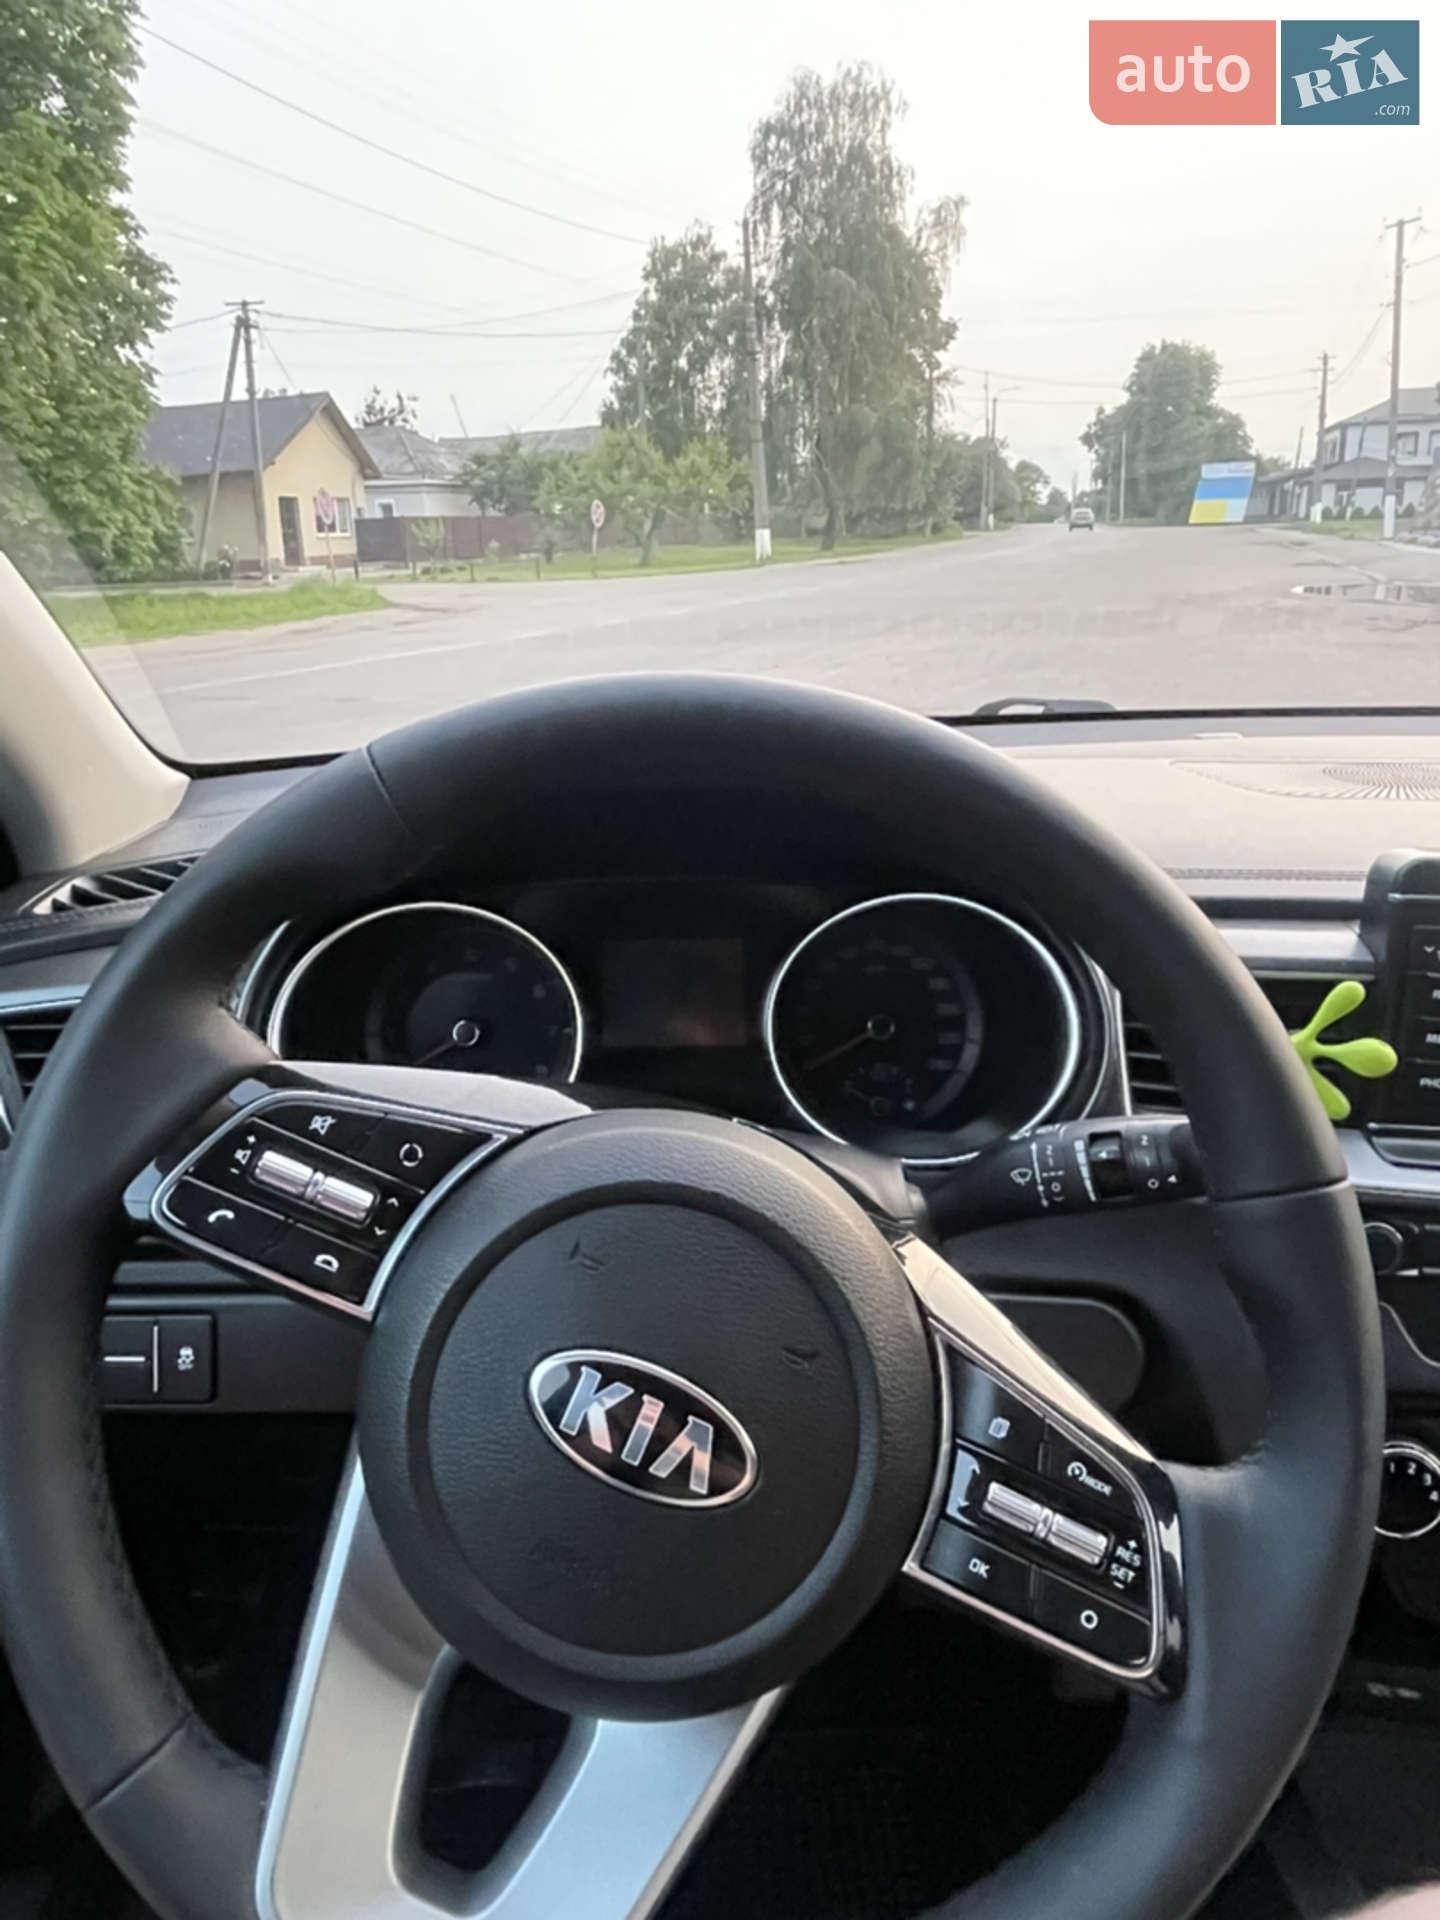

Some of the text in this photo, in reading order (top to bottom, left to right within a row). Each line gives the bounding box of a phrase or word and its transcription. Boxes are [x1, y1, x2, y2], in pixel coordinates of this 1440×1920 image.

[559, 1365, 714, 1495] KIA
[1407, 1462, 1417, 1475] 2
[1115, 1546, 1142, 1567] RES
[968, 1558, 990, 1578] OK
[1109, 1562, 1136, 1584] SET
